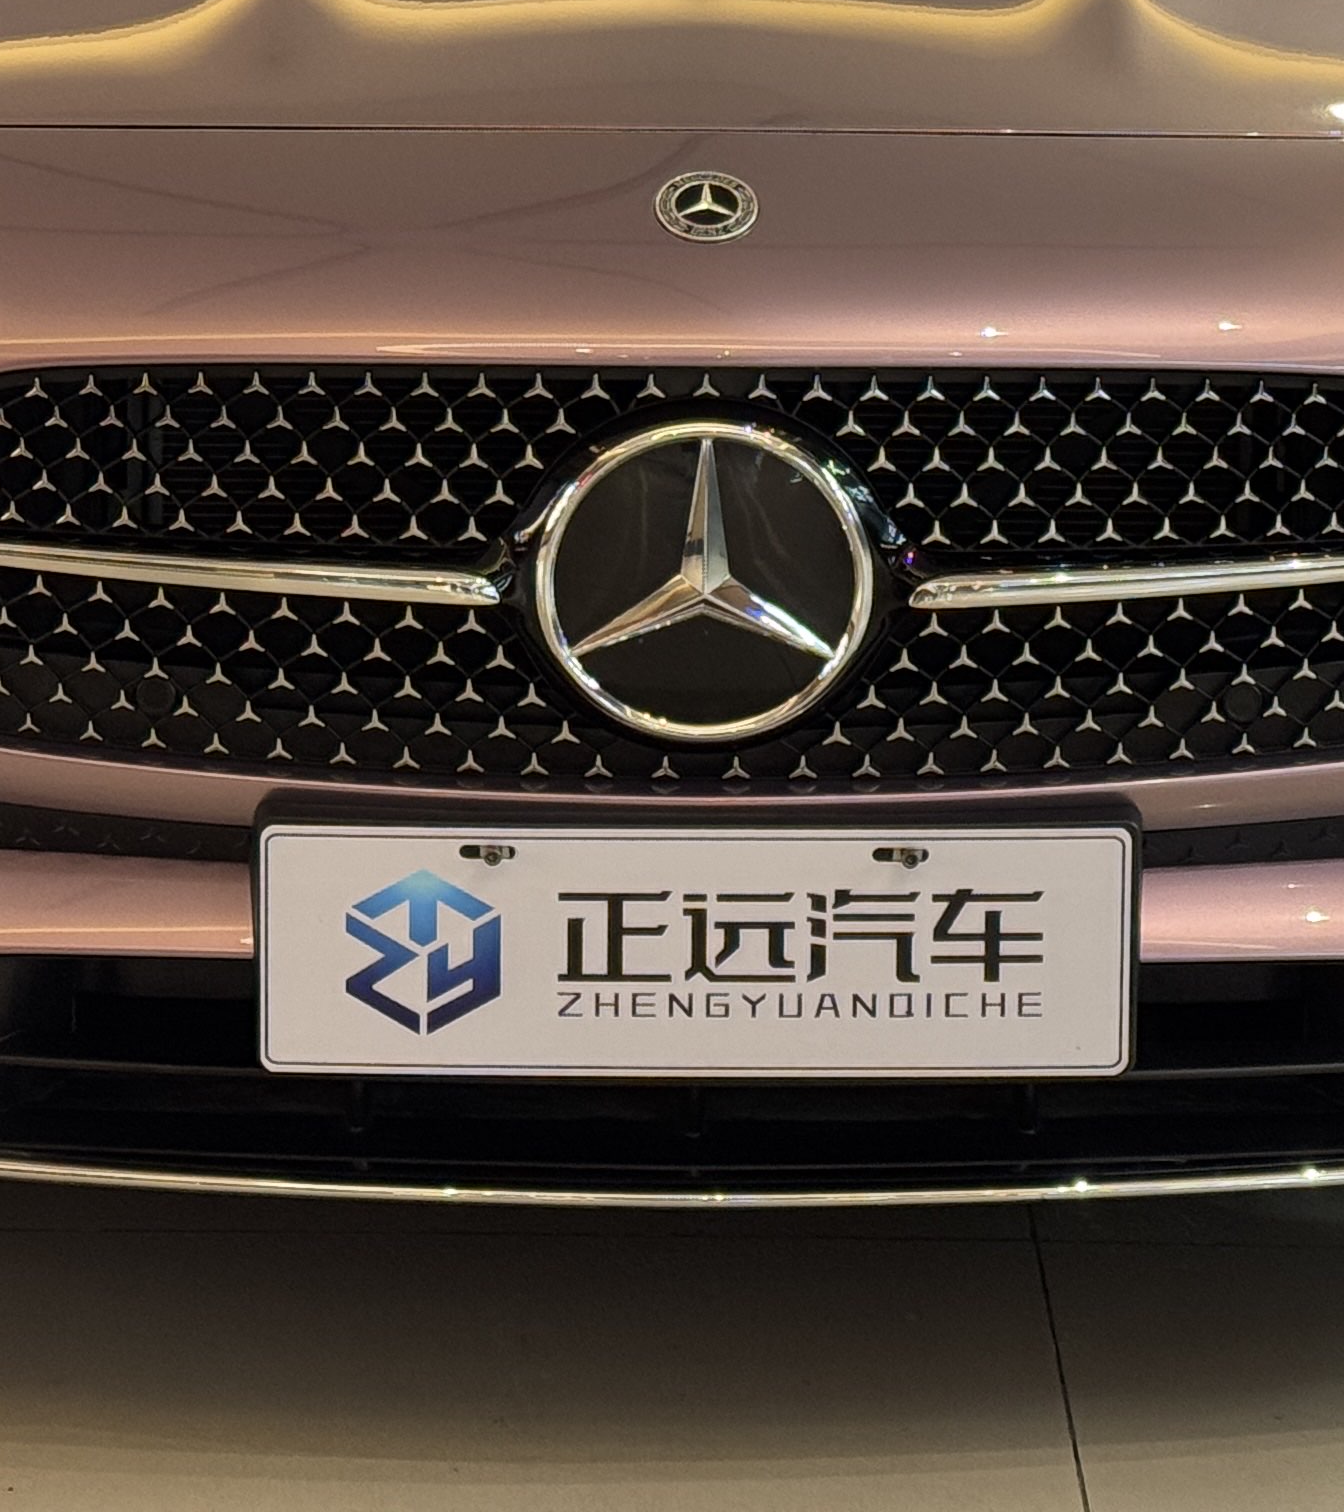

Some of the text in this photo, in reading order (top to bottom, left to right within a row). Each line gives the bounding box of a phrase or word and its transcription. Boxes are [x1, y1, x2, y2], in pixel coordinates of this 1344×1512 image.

[558, 889, 1046, 983] 正远汽车
[558, 992, 1045, 1019] ZHENGYUANQICHE
